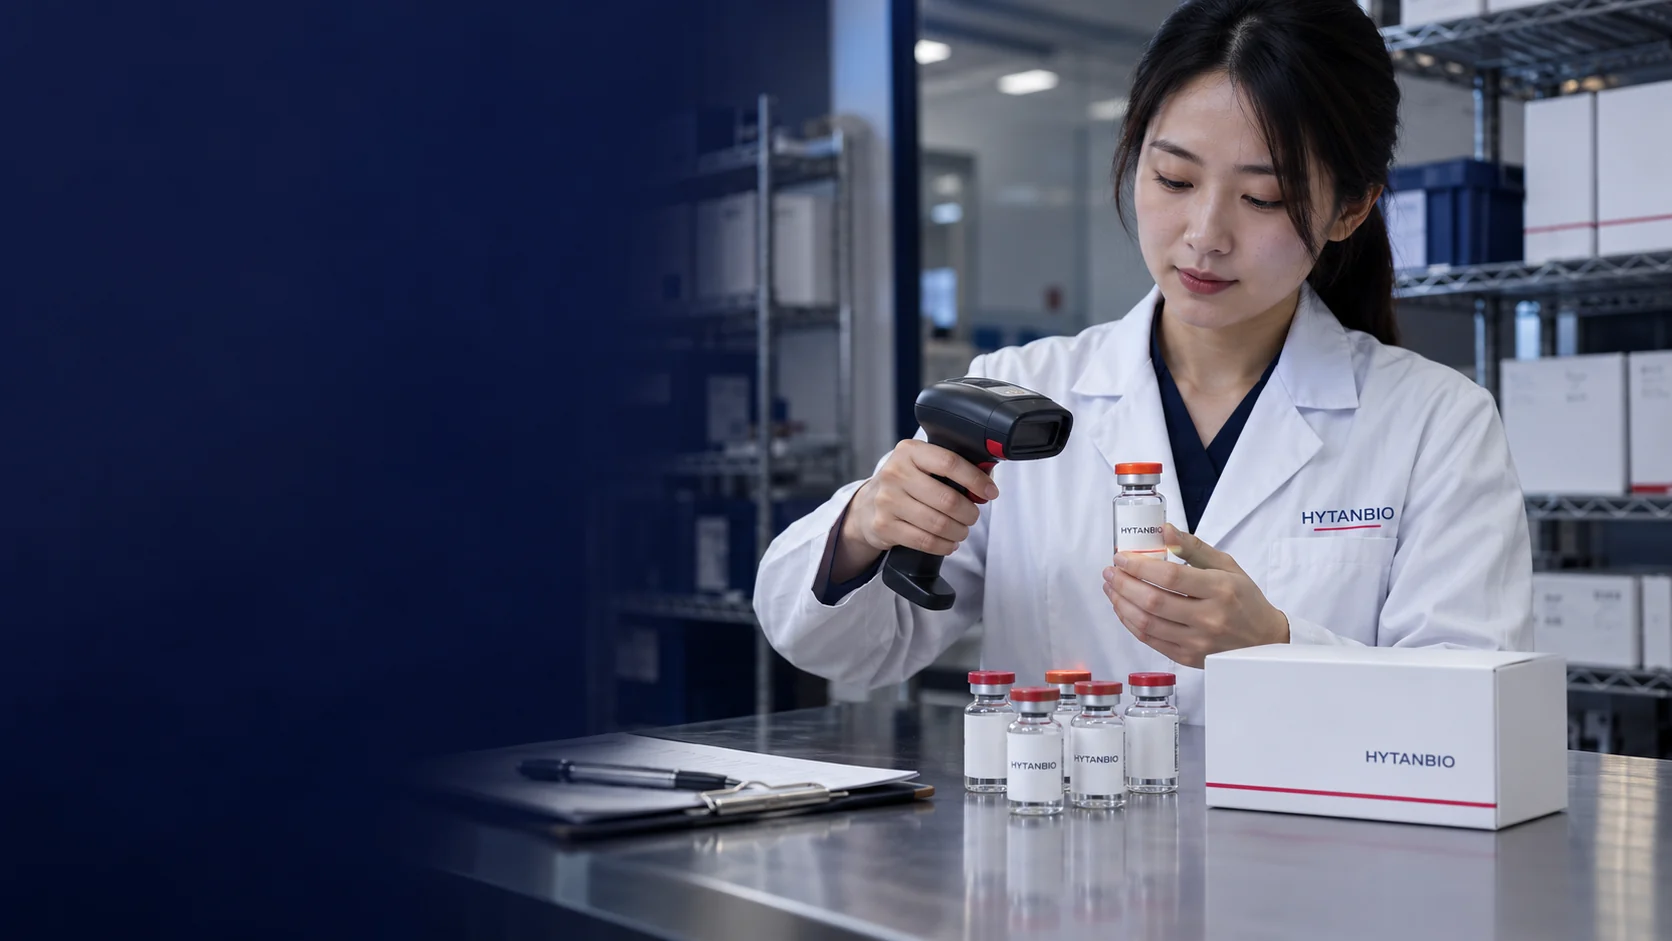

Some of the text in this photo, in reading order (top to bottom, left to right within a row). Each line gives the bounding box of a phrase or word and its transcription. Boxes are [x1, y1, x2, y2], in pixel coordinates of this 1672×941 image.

[1302, 506, 1395, 524] HYTANBIO
[1120, 526, 1163, 534] HYTANBIO
[1073, 754, 1119, 763] HYTANBIO
[1365, 750, 1455, 768] HYTANBIO
[1011, 761, 1057, 770] HYTANBIO
